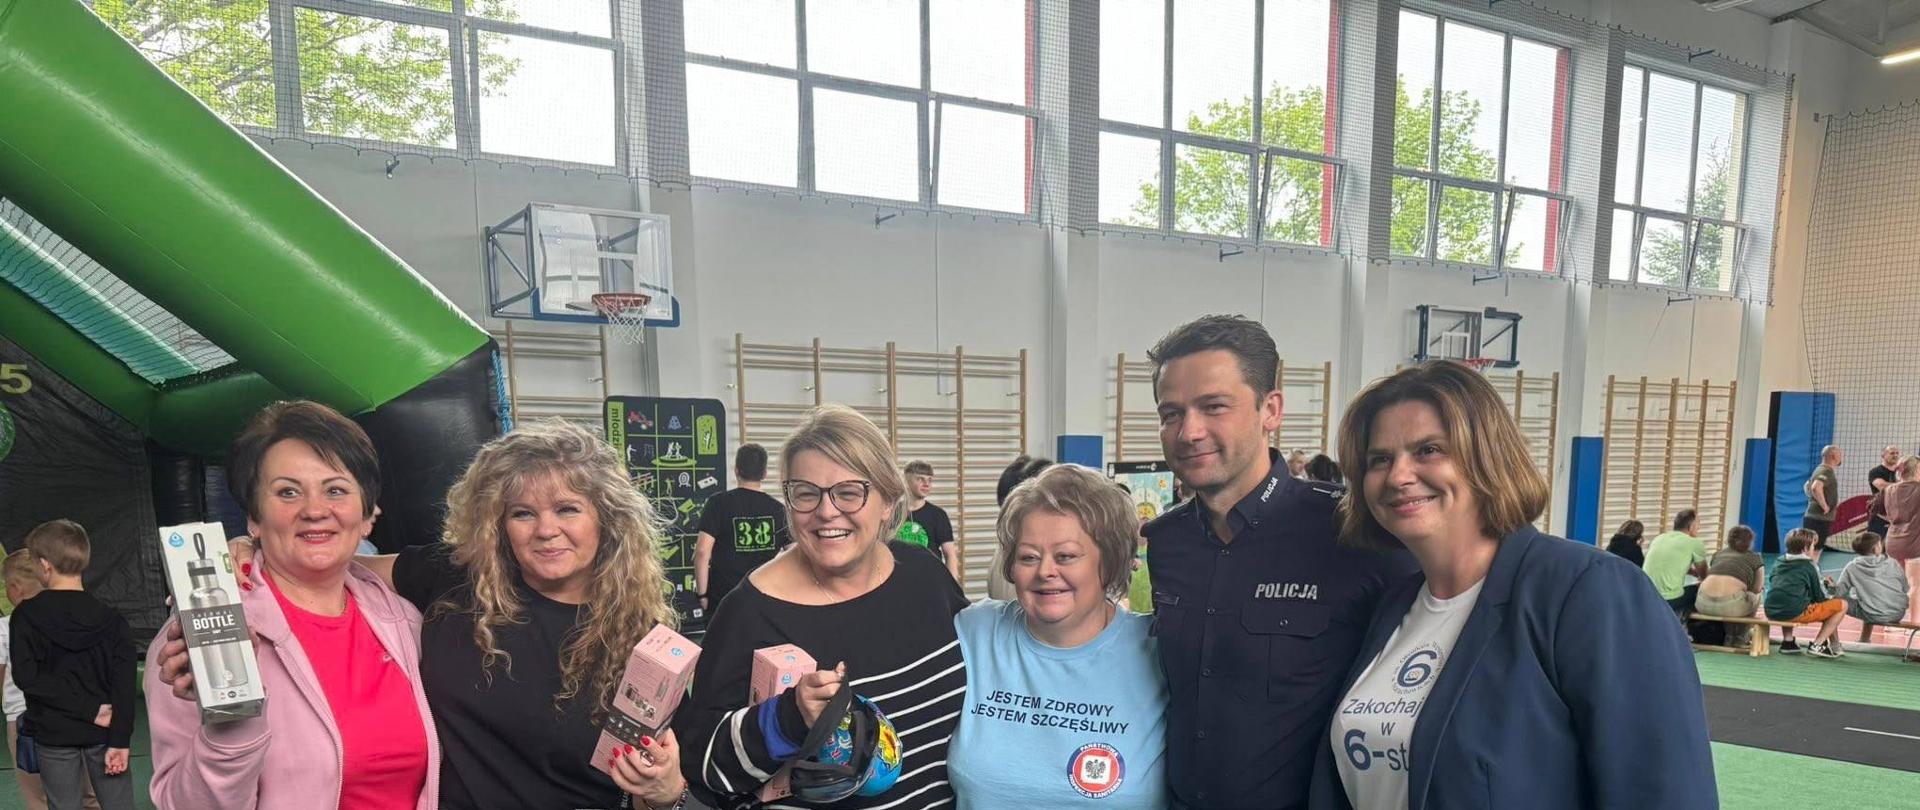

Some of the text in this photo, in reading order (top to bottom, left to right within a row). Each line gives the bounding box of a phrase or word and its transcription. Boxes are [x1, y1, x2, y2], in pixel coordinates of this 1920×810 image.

[611, 408, 622, 450] młodzi
[1260, 477, 1278, 502] POLICJA
[739, 522, 771, 545] 38
[1255, 583, 1318, 600] POLICJA
[193, 614, 235, 630] BOTTLE
[1397, 650, 1437, 687] 6
[986, 690, 1114, 717] JESTEM ZDROWY
[1342, 697, 1425, 717] Zakochaj
[971, 703, 1129, 734] JESTEM SZCZĘŚLIWY
